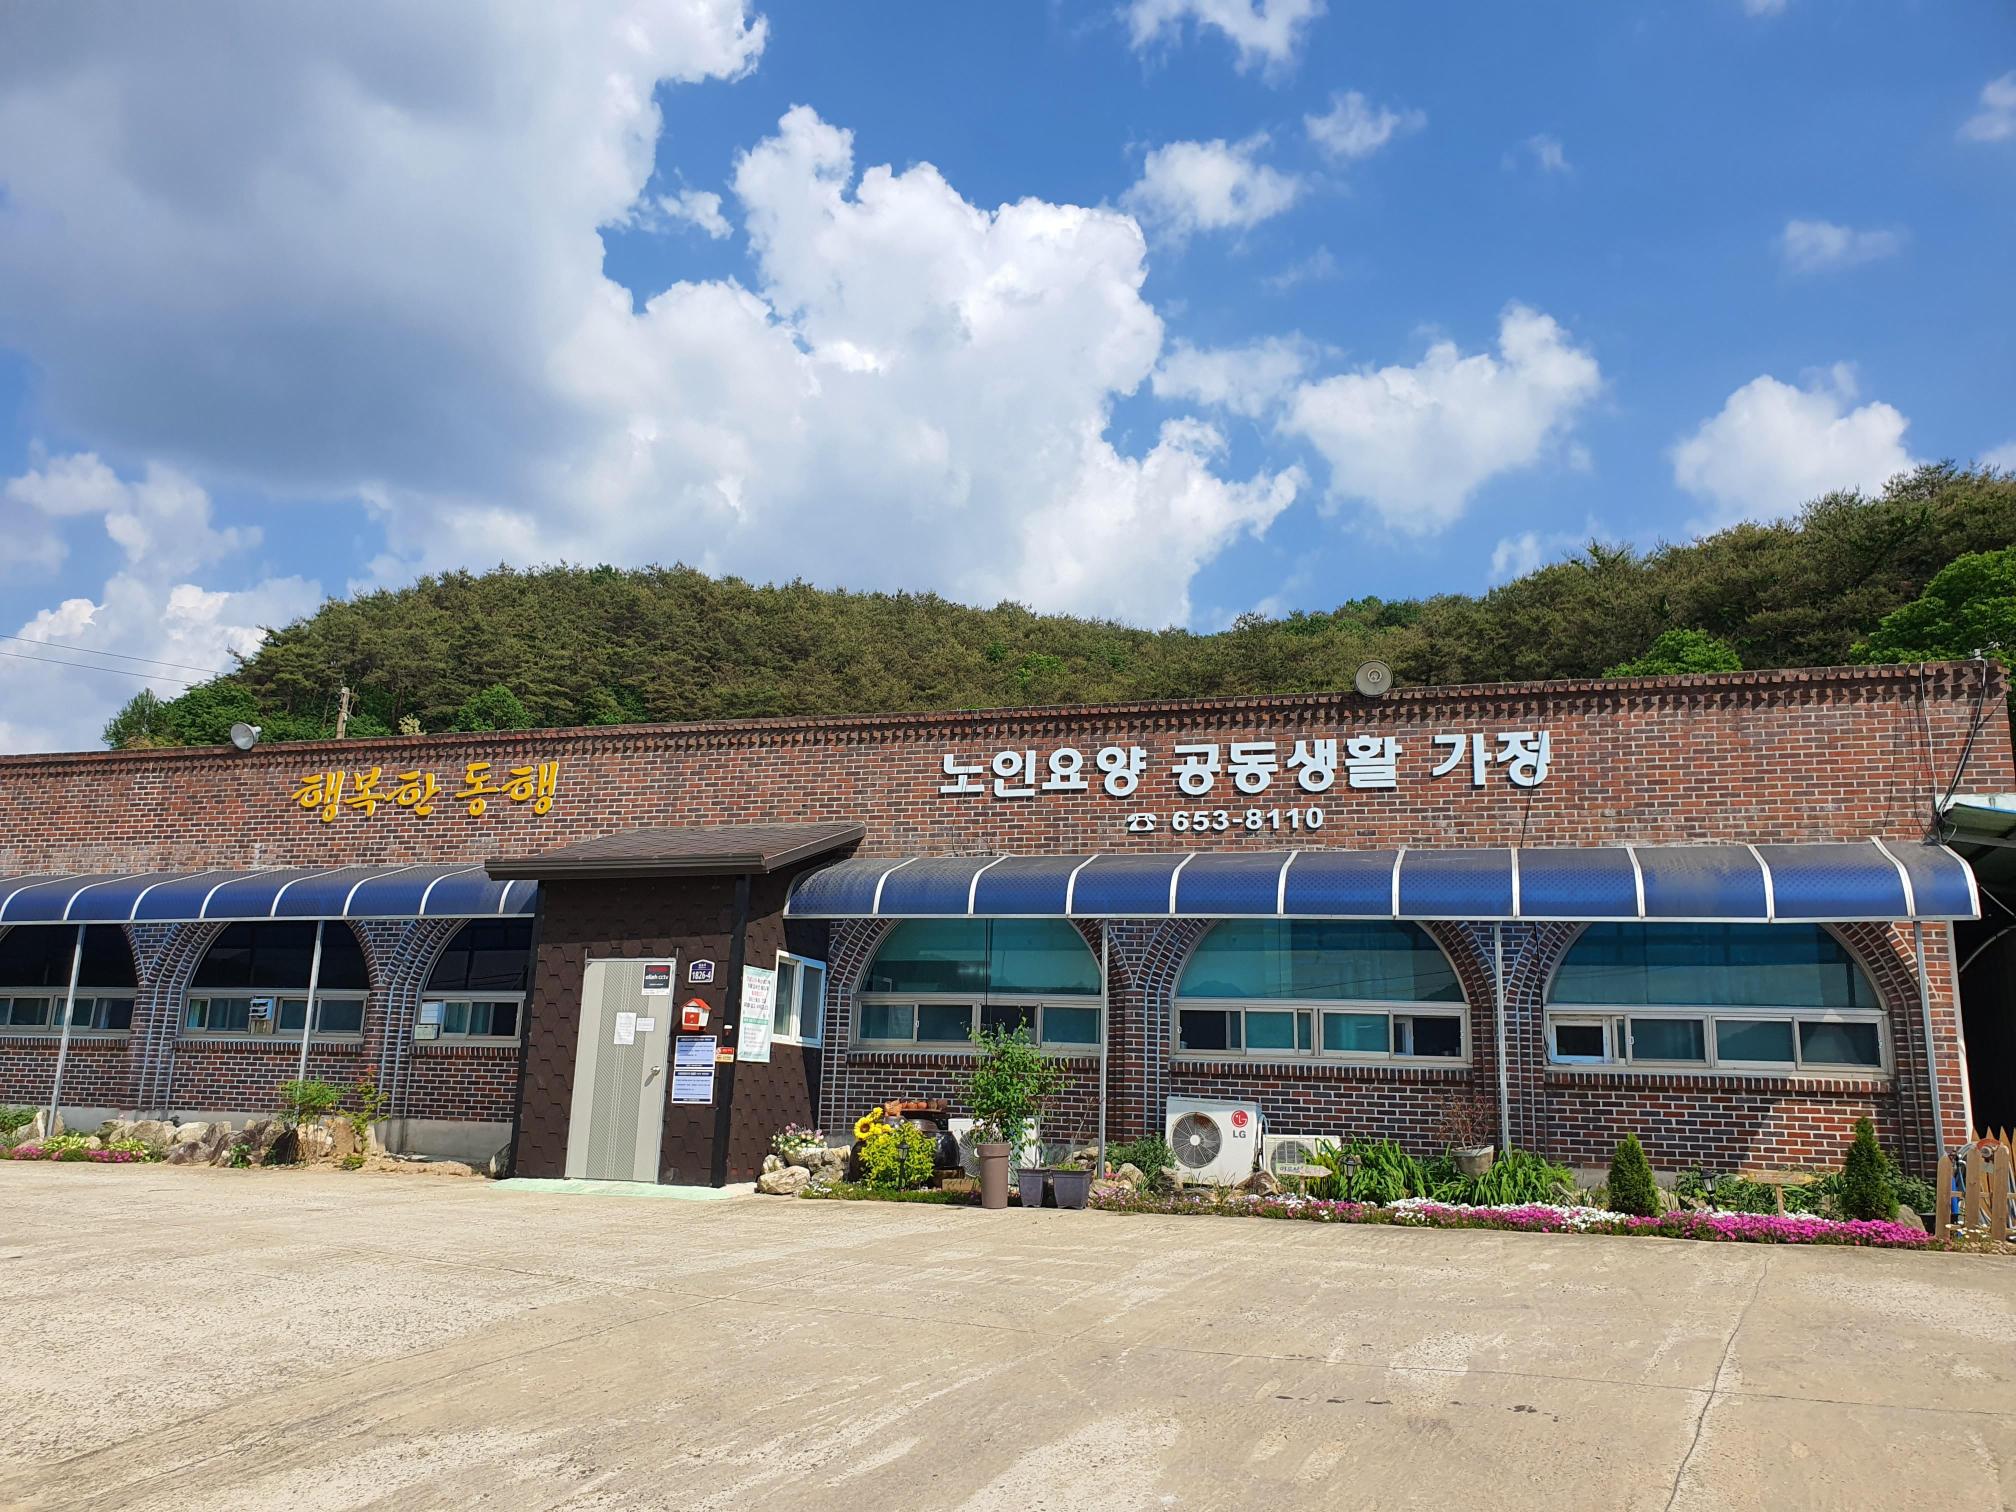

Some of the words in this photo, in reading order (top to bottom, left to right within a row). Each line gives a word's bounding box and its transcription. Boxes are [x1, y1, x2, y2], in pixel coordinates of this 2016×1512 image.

[940, 746, 1147, 798] 노인요양
[1172, 735, 1402, 796] 공동생활
[1432, 730, 1551, 788] 가정
[292, 767, 442, 823] 행복한
[455, 761, 559, 816] 동행
[1172, 807, 1325, 832] 653-8110
[1232, 1129, 1247, 1139] LG
